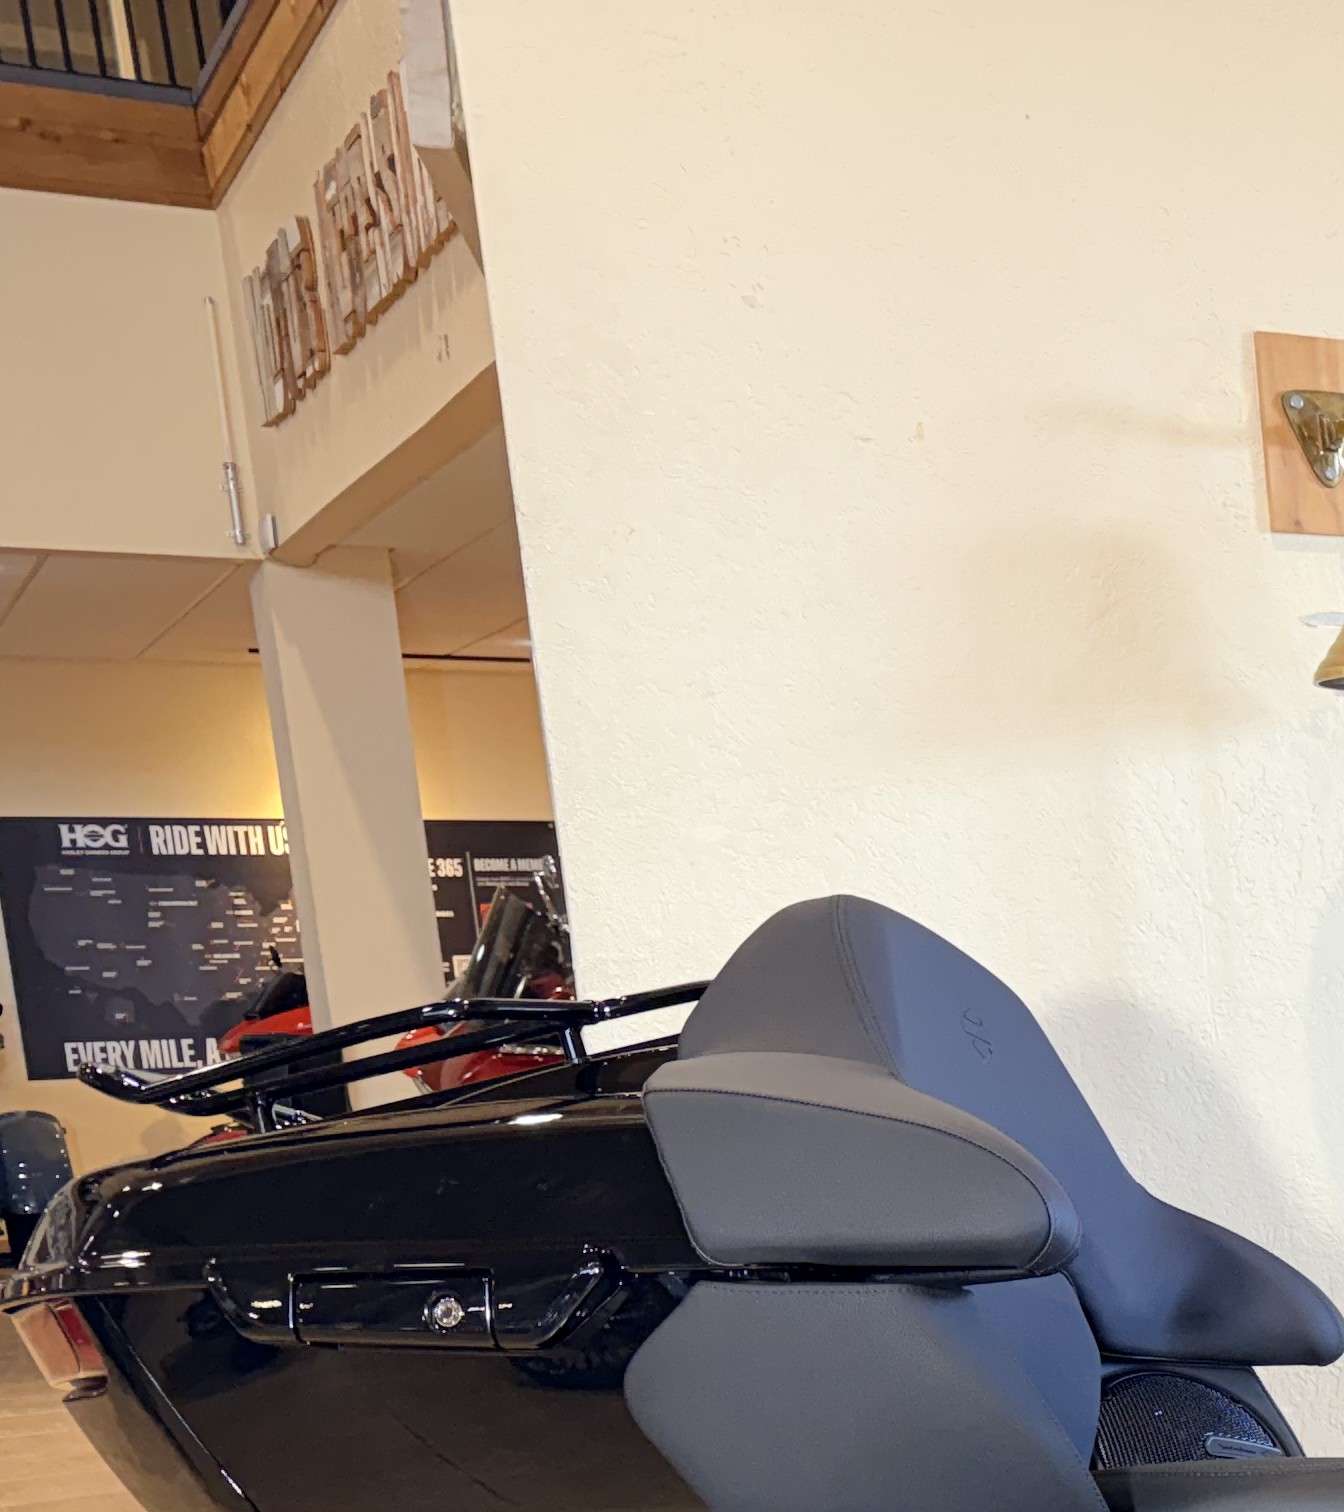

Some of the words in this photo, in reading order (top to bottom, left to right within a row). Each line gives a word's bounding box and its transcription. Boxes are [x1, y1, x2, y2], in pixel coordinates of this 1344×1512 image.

[58, 823, 130, 849] HOG
[149, 825, 204, 856] RIDE
[203, 825, 266, 856] WITH
[436, 857, 463, 878] 365
[64, 1040, 136, 1072] EVERY
[139, 1038, 203, 1070] MILE,
